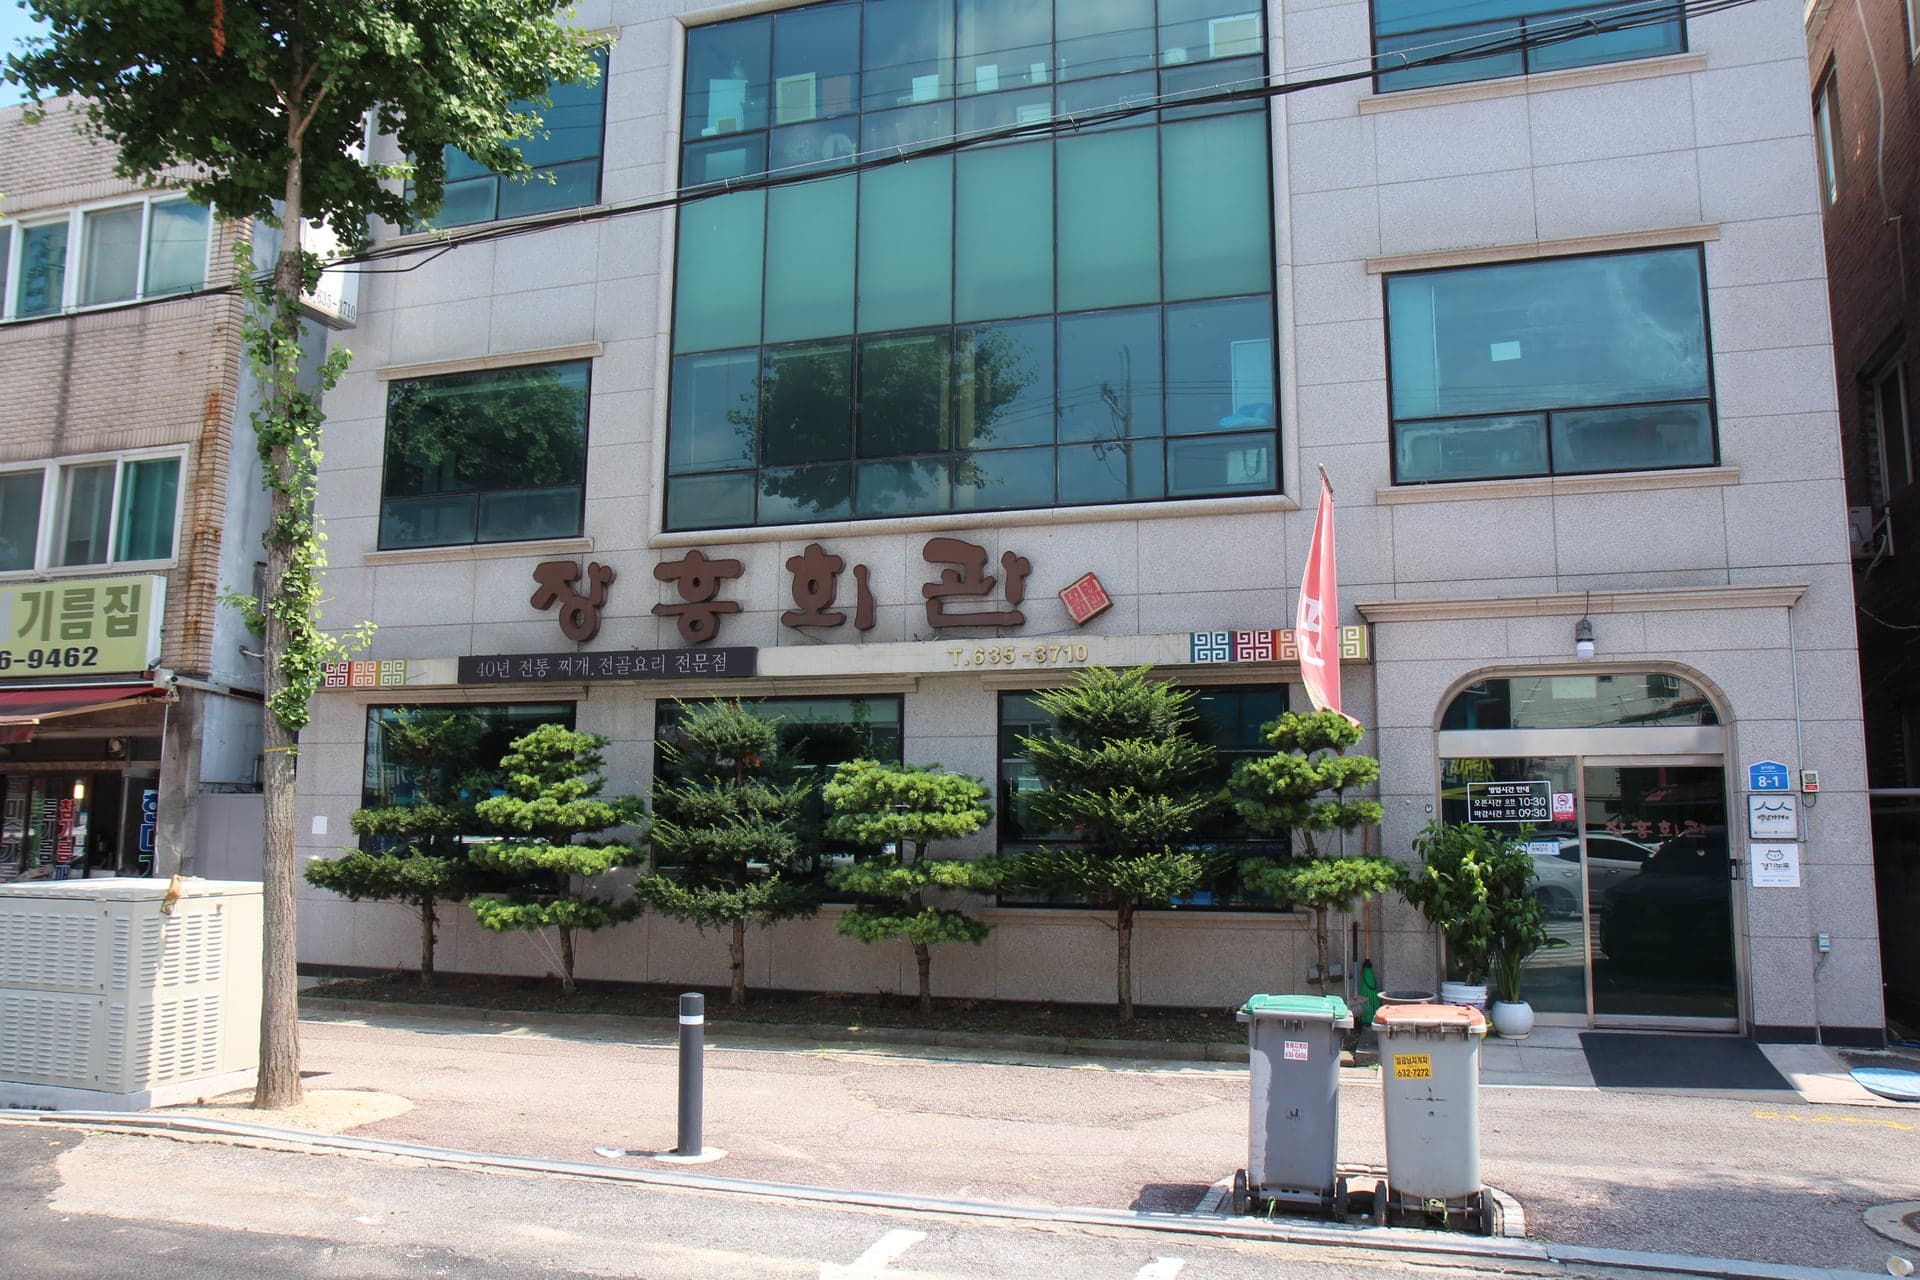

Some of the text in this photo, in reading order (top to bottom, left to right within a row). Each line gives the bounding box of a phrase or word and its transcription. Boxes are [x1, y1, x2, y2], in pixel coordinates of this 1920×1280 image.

[530, 537, 1033, 643] 장흥회관
[17, 584, 142, 642] 기름집
[476, 659, 511, 678] 40년
[518, 658, 551, 678] 전통
[675, 651, 727, 673] 전문점
[947, 644, 1089, 666] T.635-3710
[1758, 775, 1779, 788] 8-1
[1519, 797, 1546, 807] 10:30
[1519, 808, 1547, 818] 09:30
[56, 798, 75, 863] 참기름
[1397, 1068, 1430, 1078] 632-7272
